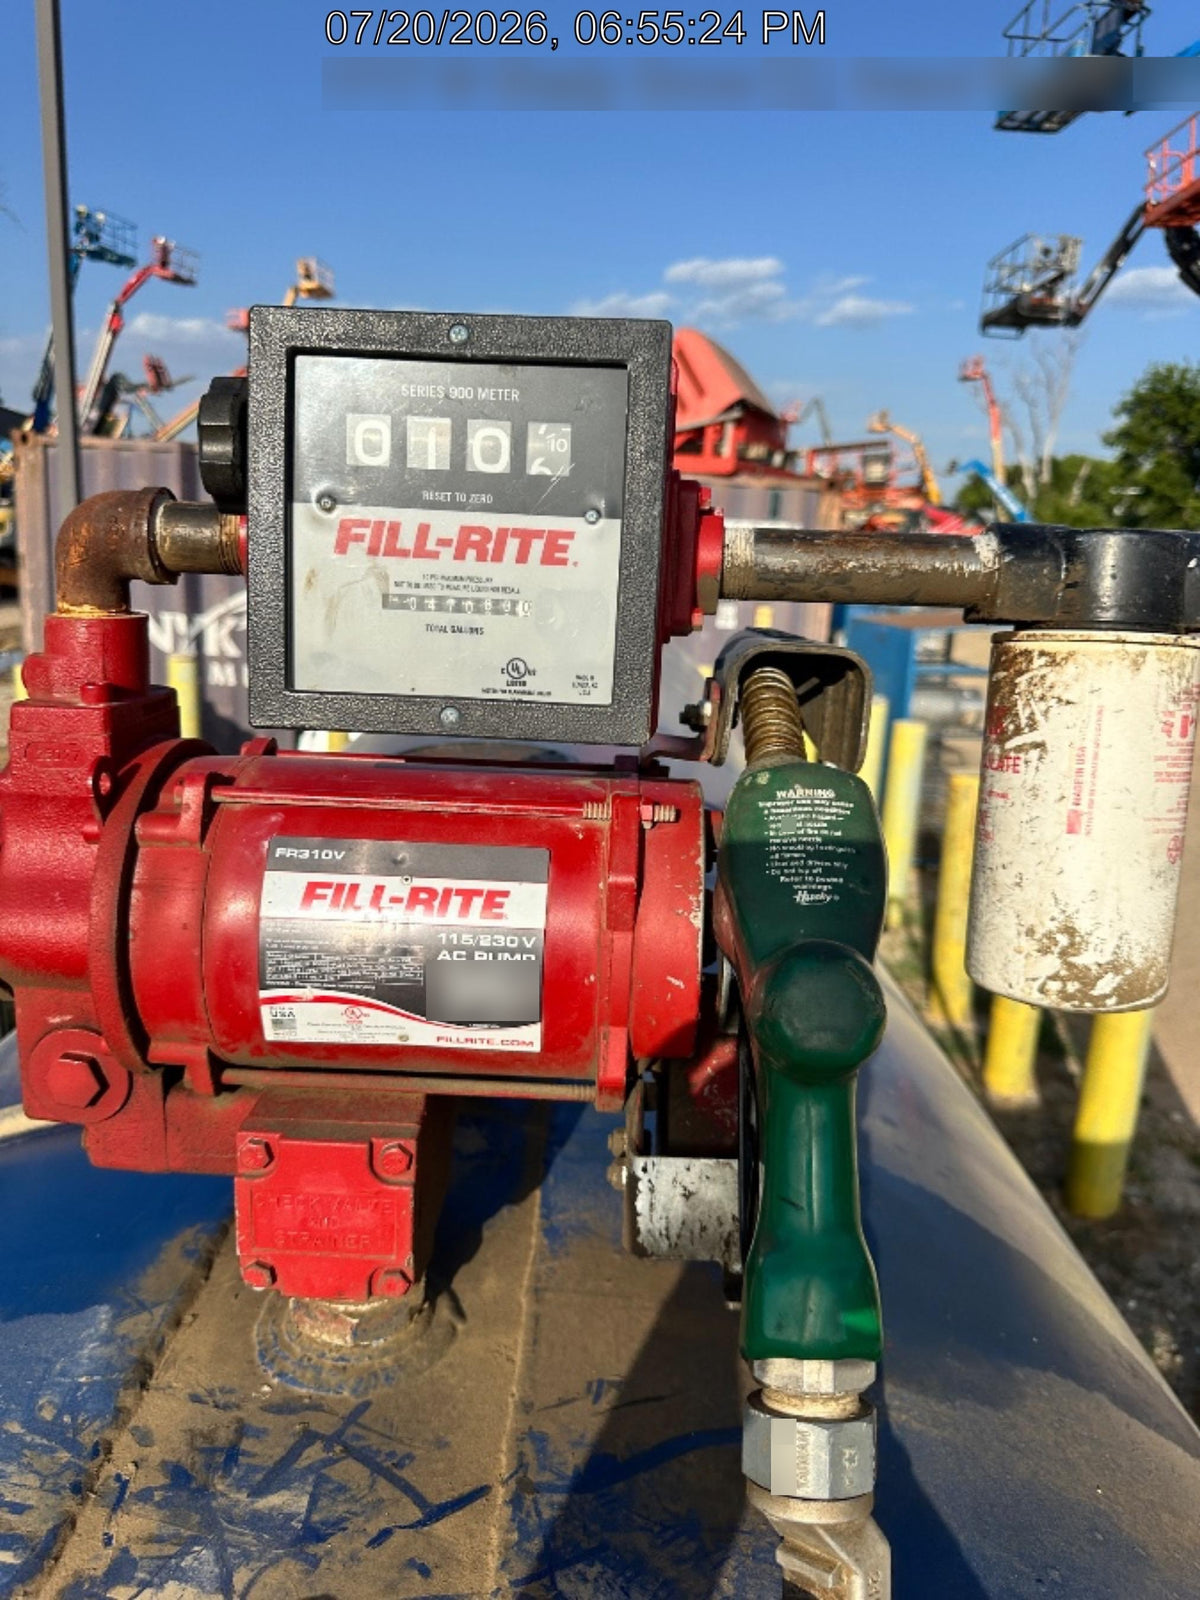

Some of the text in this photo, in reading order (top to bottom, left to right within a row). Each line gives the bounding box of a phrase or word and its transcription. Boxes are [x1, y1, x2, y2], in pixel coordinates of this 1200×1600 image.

[401, 383, 520, 402] SERIES 900 METER
[422, 490, 494, 505] RESET TO ZERO
[334, 518, 576, 567] FILL-RITE
[776, 788, 836, 799] WARNING
[275, 847, 345, 861] FR310V
[300, 881, 511, 920] FILL-RITE
[438, 933, 536, 948] 115/230 V
[436, 1035, 534, 1047] FILLRITE.COM
